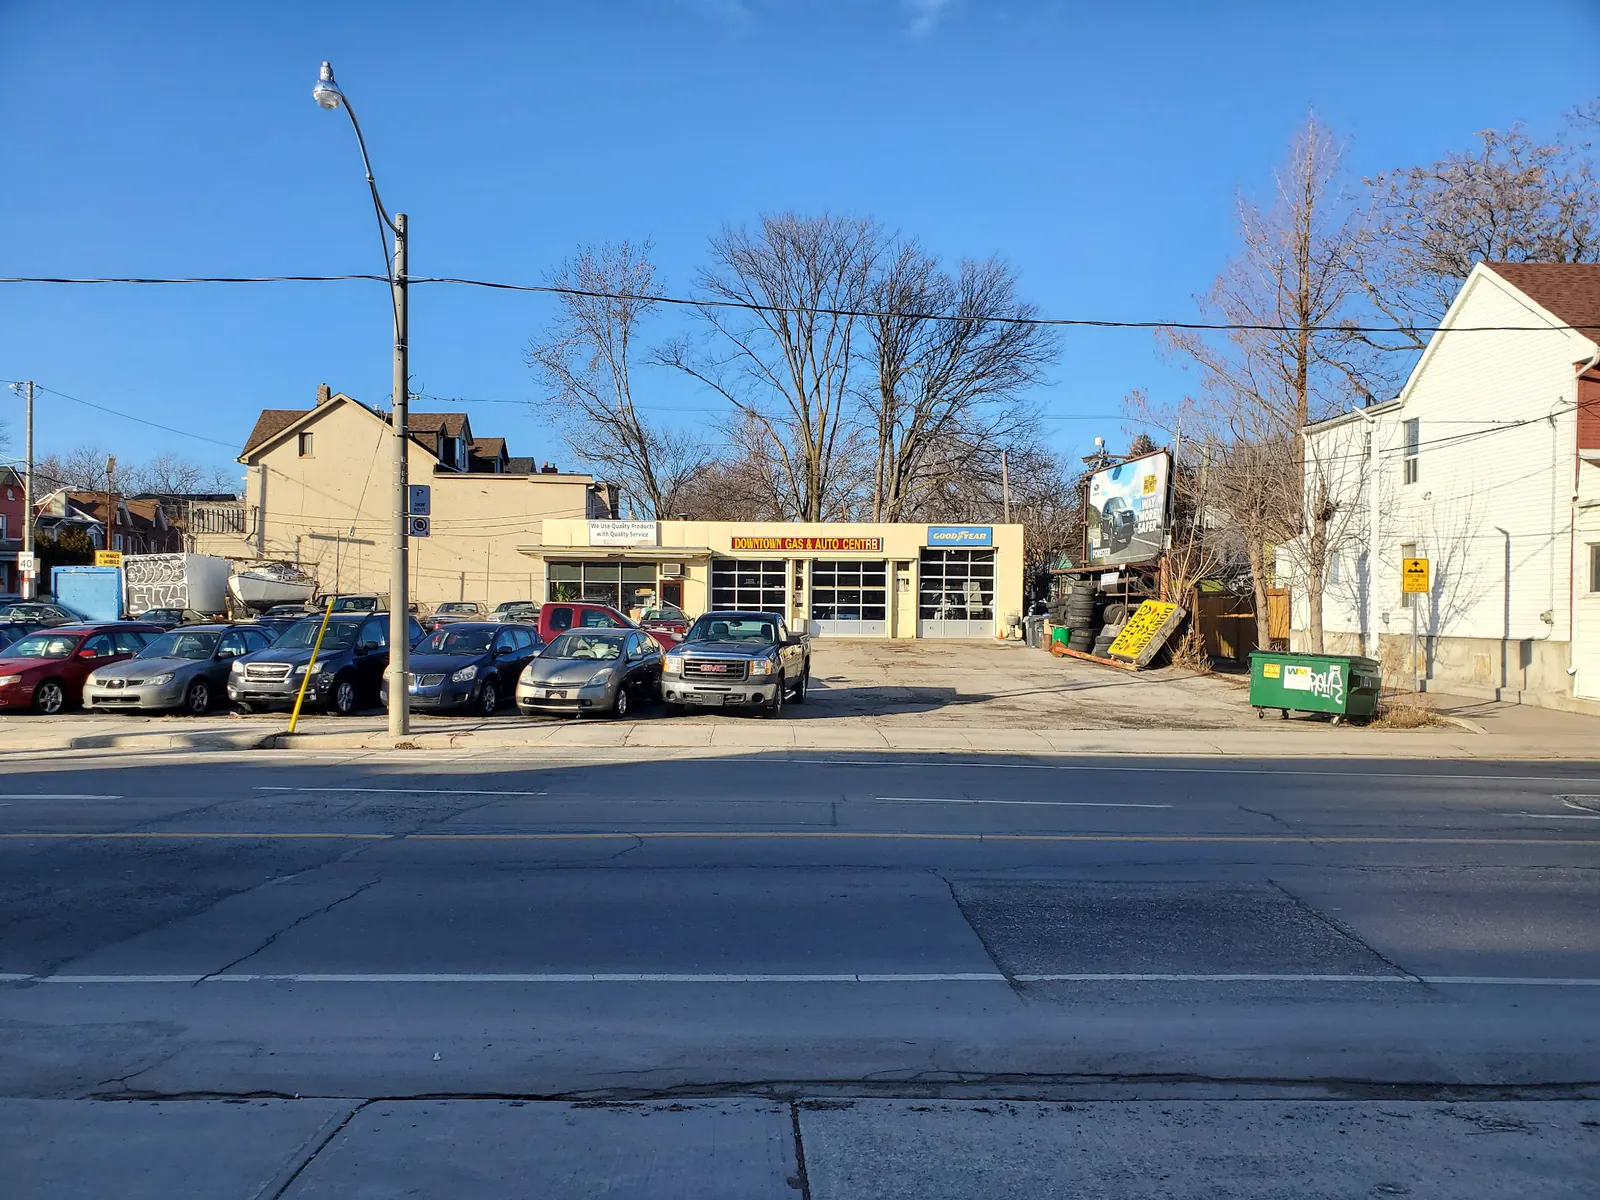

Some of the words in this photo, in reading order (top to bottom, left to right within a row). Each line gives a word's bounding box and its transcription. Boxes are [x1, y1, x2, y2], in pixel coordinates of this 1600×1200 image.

[1142, 496, 1157, 510] WAY
[611, 522, 631, 530] Quality
[1137, 520, 1157, 535] SAFER
[933, 531, 987, 542] GOODYEAR
[735, 538, 782, 549] DOWNTOWN
[785, 538, 804, 549] GAS
[806, 539, 812, 549] &
[815, 539, 839, 550] AUTO
[20, 559, 33, 568] 40
[1112, 603, 1149, 650] CENTRE
[1131, 606, 1173, 655] DOWNTOWN
[700, 664, 727, 672] GMC
[1287, 667, 1308, 676] WM
